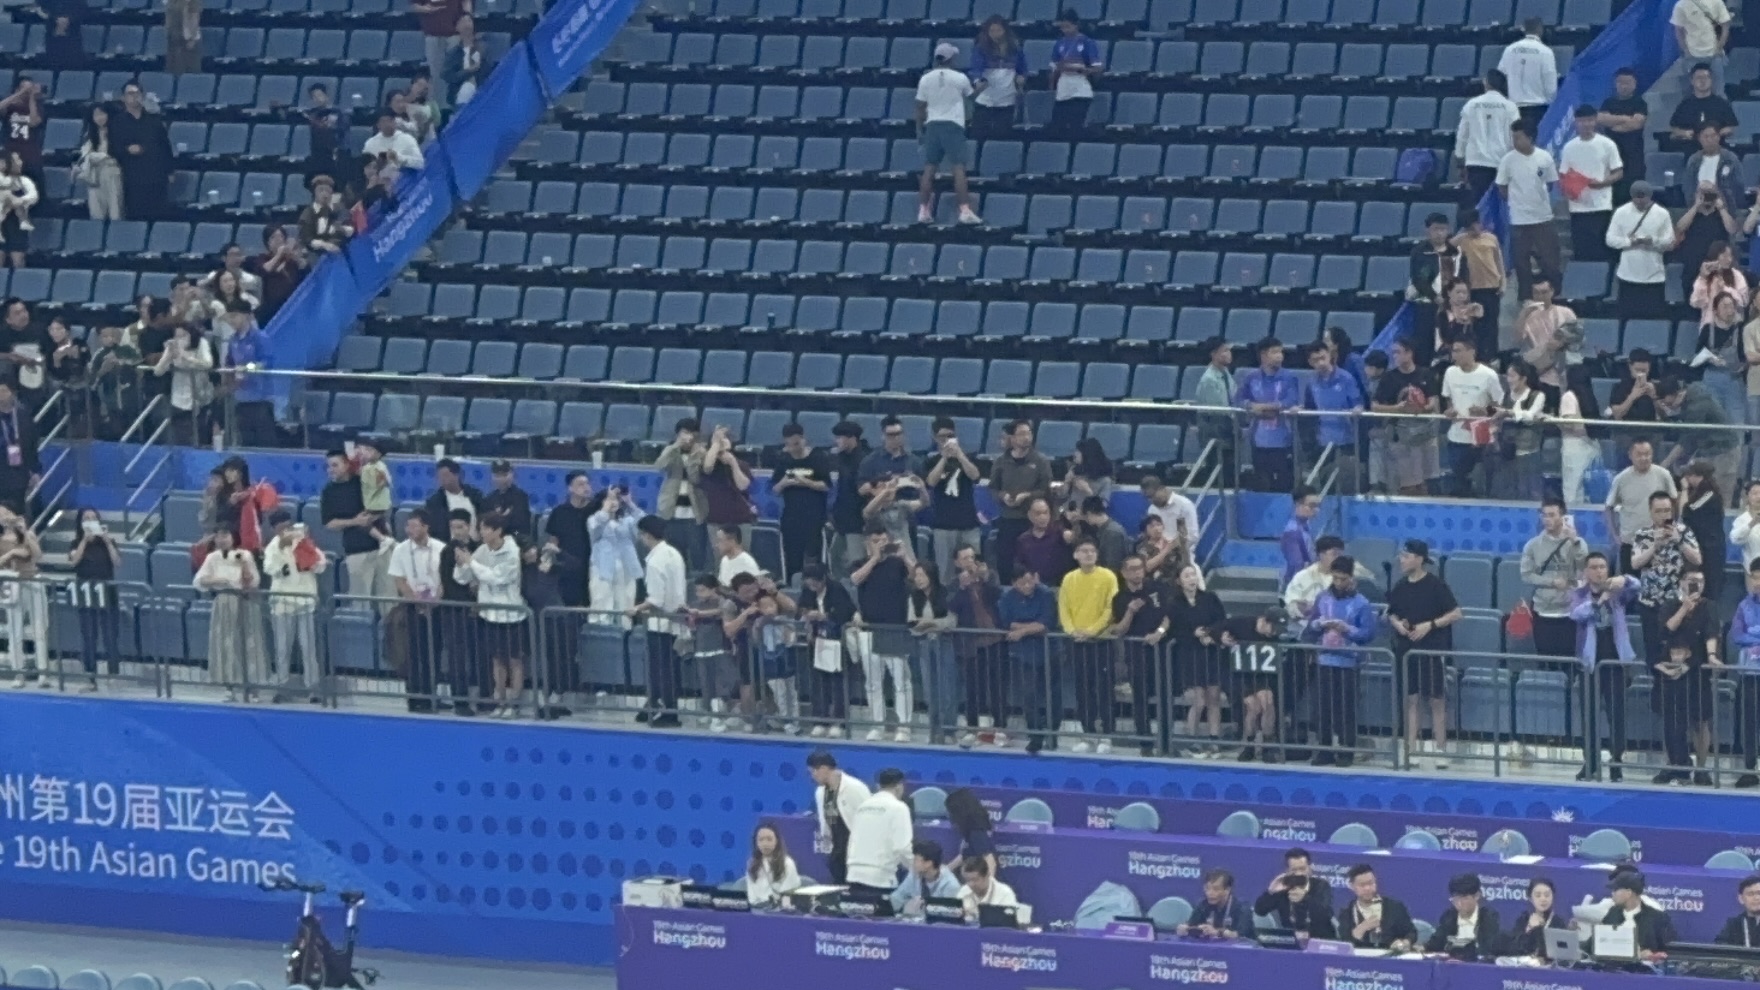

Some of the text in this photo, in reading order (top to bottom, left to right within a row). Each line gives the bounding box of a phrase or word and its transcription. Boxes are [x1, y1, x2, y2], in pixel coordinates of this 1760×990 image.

[67, 581, 105, 608] 111
[1230, 644, 1277, 672] 112
[14, 834, 297, 887] 19th Asian Games
[999, 854, 1041, 869] gzhou
[1129, 862, 1201, 879] Hangzhou
[653, 931, 727, 949] Hangzhou
[815, 942, 890, 961] Hangzhou
[981, 953, 1057, 972] Hangzhou
[1150, 966, 1228, 985] Hangzhou
